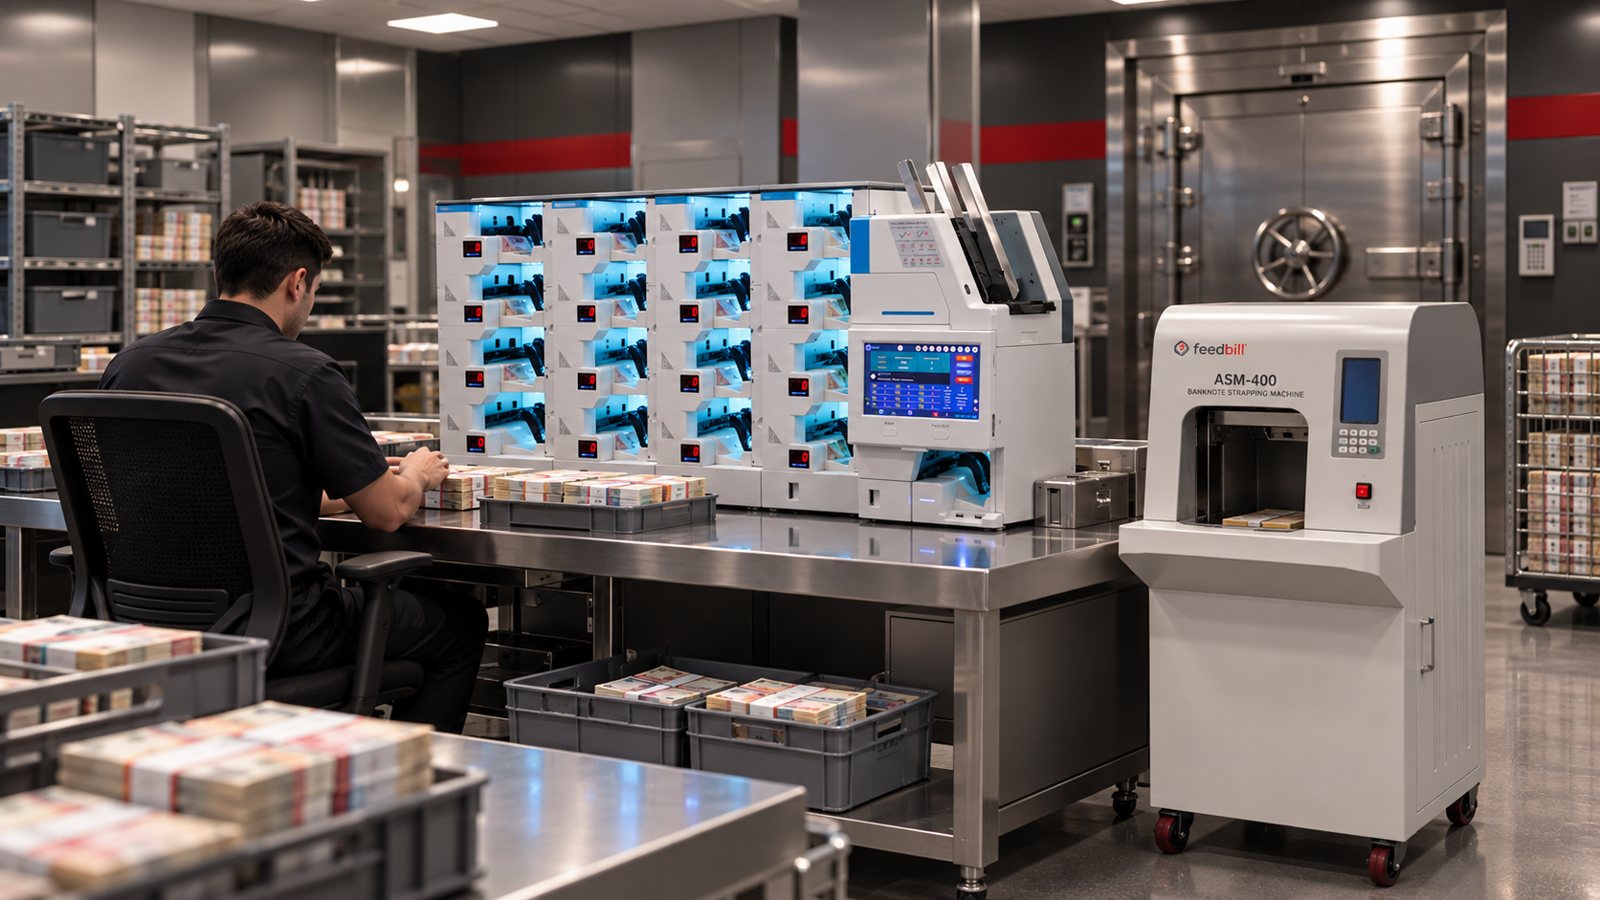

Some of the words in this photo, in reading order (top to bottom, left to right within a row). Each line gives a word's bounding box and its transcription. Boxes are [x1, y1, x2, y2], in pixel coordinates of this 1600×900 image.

[1193, 343, 1245, 356] feedbill
[1214, 373, 1277, 387] ASM-400
[1187, 388, 1226, 396] BANKNOTE
[1227, 389, 1268, 397] STRAPPING
[1269, 390, 1305, 398] MACHINE
